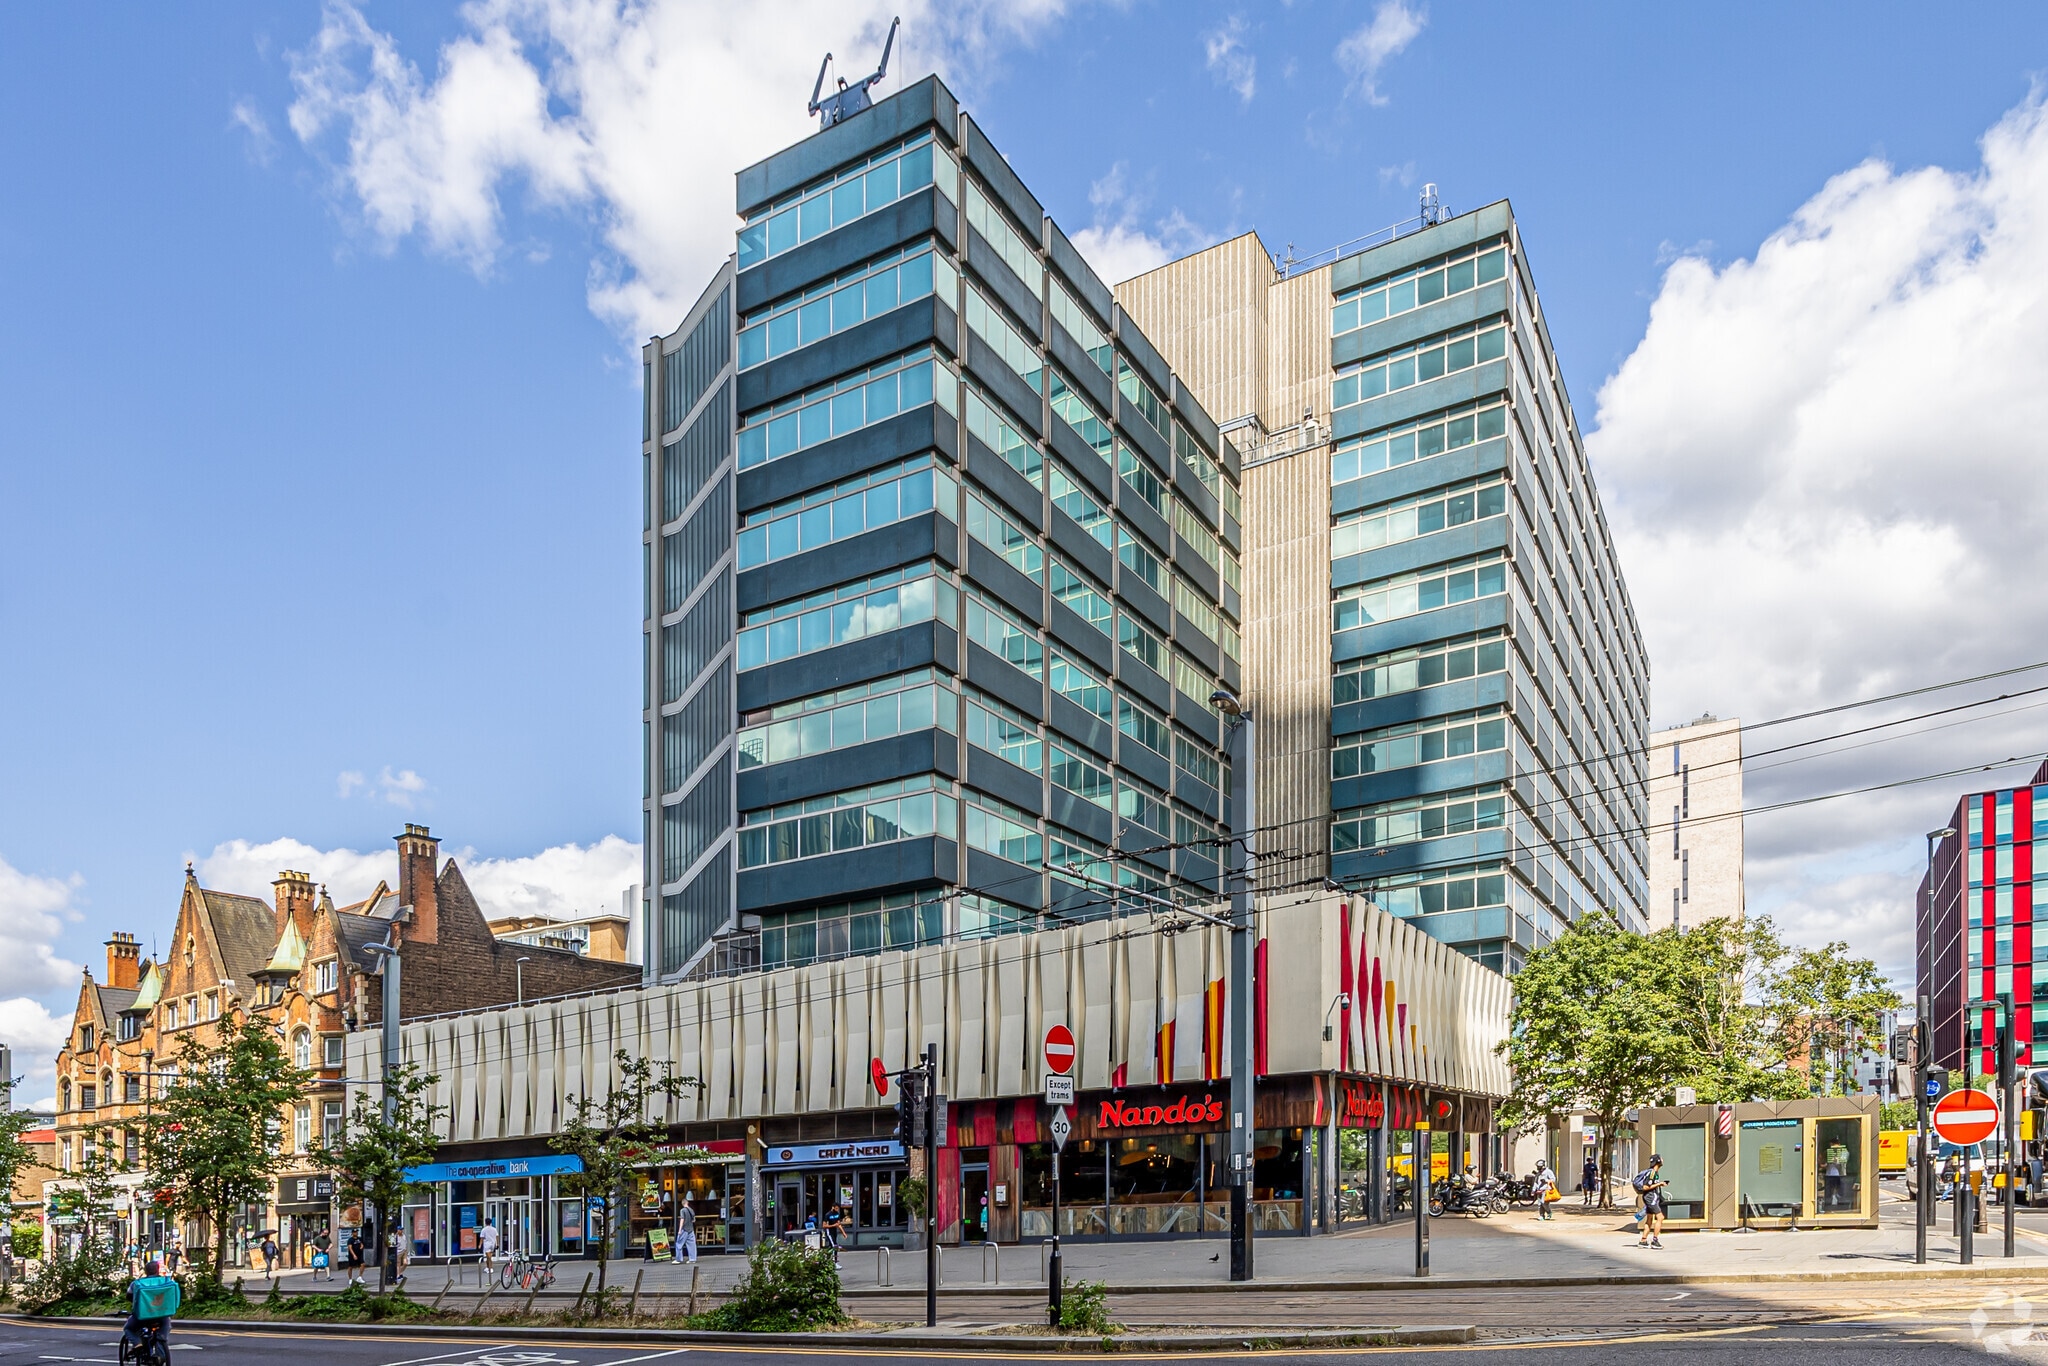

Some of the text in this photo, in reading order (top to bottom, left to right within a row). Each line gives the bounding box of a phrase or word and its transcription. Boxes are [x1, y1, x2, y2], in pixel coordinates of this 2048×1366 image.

[1049, 1080, 1071, 1089] Except
[1051, 1091, 1069, 1099] trams
[1346, 1089, 1384, 1118] Nando's
[1097, 1094, 1223, 1128] Nando's
[1053, 1122, 1068, 1134] 30
[818, 1145, 890, 1159] CAFFÈ NERO
[445, 1160, 529, 1179] The co-operative bank
